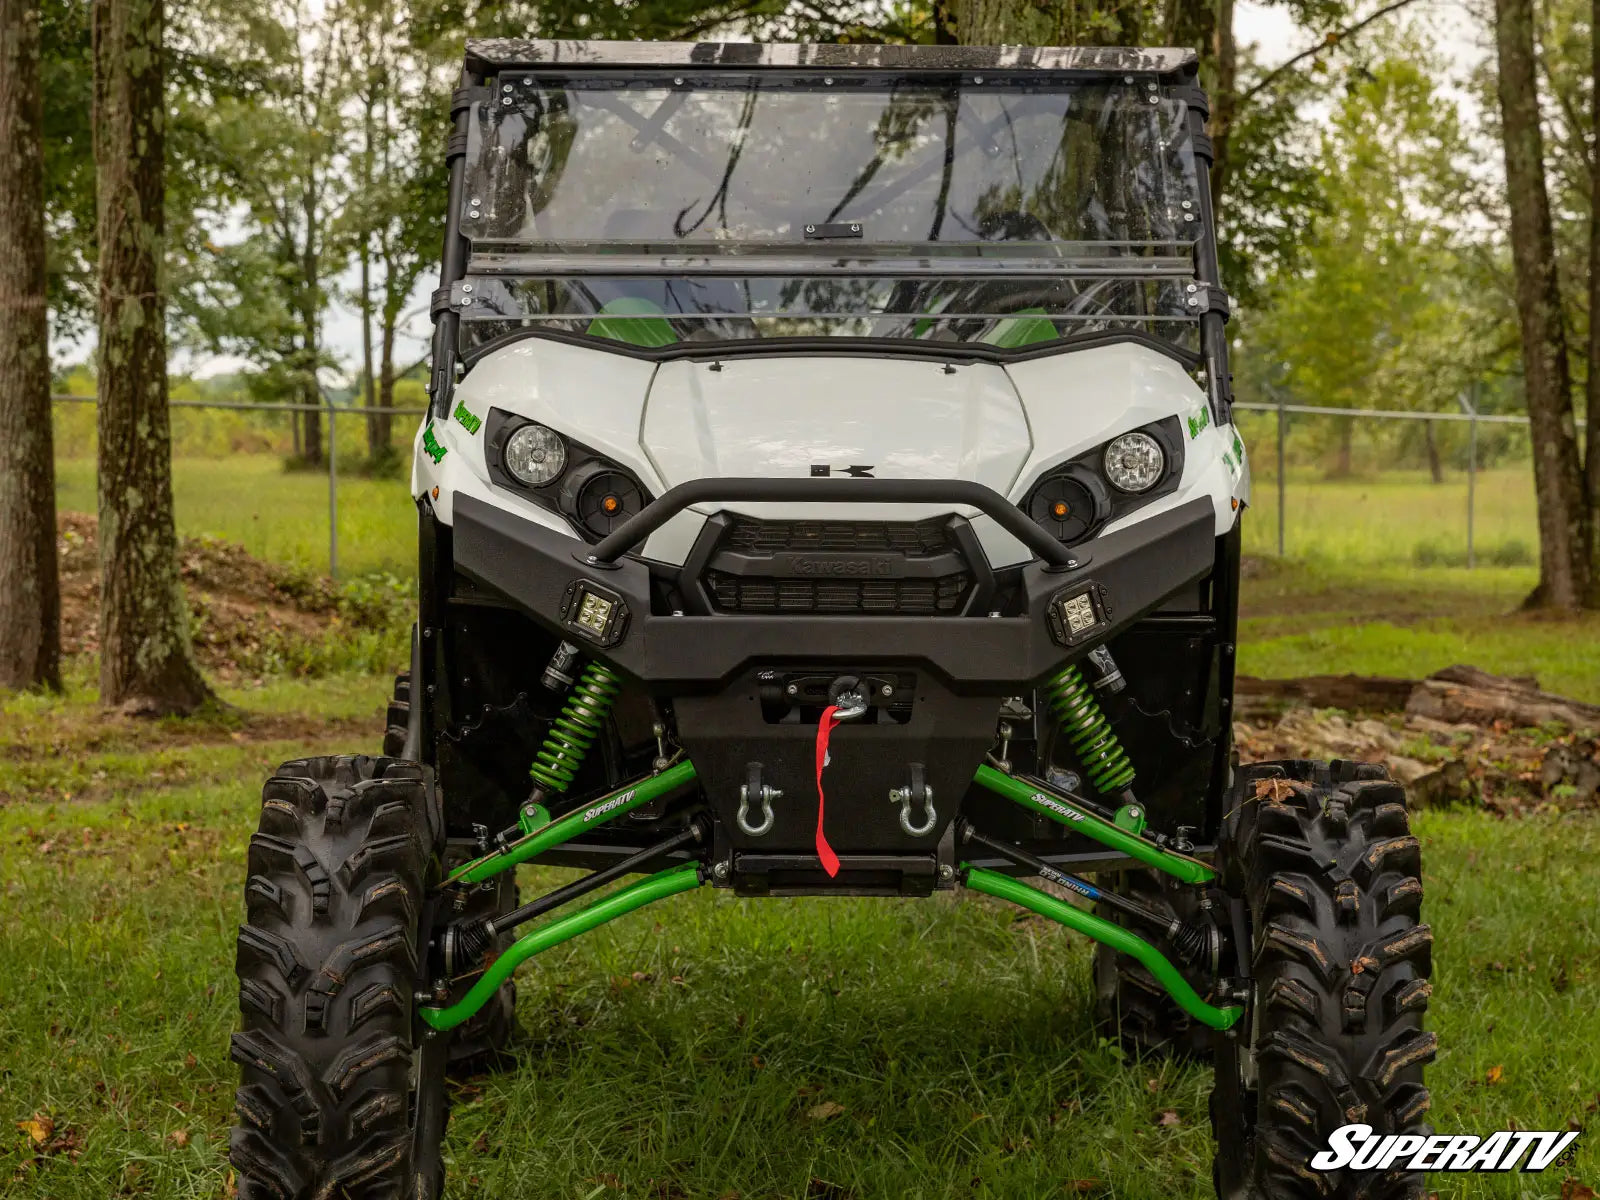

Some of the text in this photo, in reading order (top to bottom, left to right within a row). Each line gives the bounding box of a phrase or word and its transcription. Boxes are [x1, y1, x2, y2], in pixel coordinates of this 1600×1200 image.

[790, 556, 892, 576] Kawasaki
[584, 790, 636, 822] SUPERATV
[1031, 793, 1084, 822] SUPERATV
